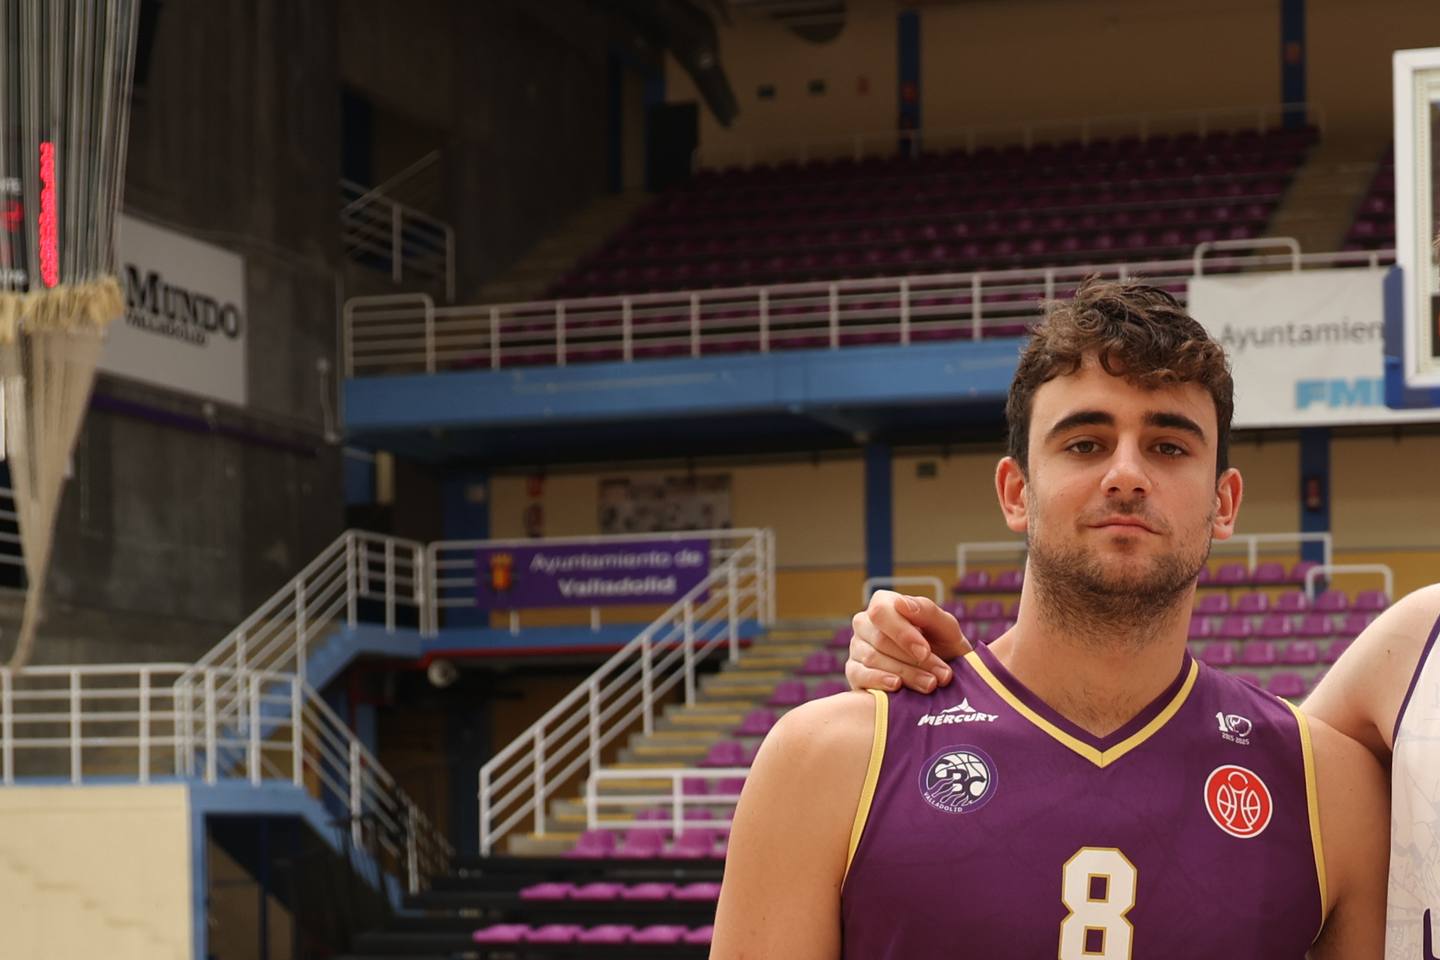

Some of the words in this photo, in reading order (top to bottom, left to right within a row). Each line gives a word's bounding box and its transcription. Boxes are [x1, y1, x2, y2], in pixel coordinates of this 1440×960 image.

[125, 262, 240, 339] MUNDO
[1221, 316, 1385, 349] Ayuntamien
[529, 550, 670, 573] Ayuntamiento
[673, 547, 703, 567] de
[558, 575, 676, 597] Valladolid
[918, 712, 999, 726] MERCURY
[924, 791, 963, 813] VALLADOLID
